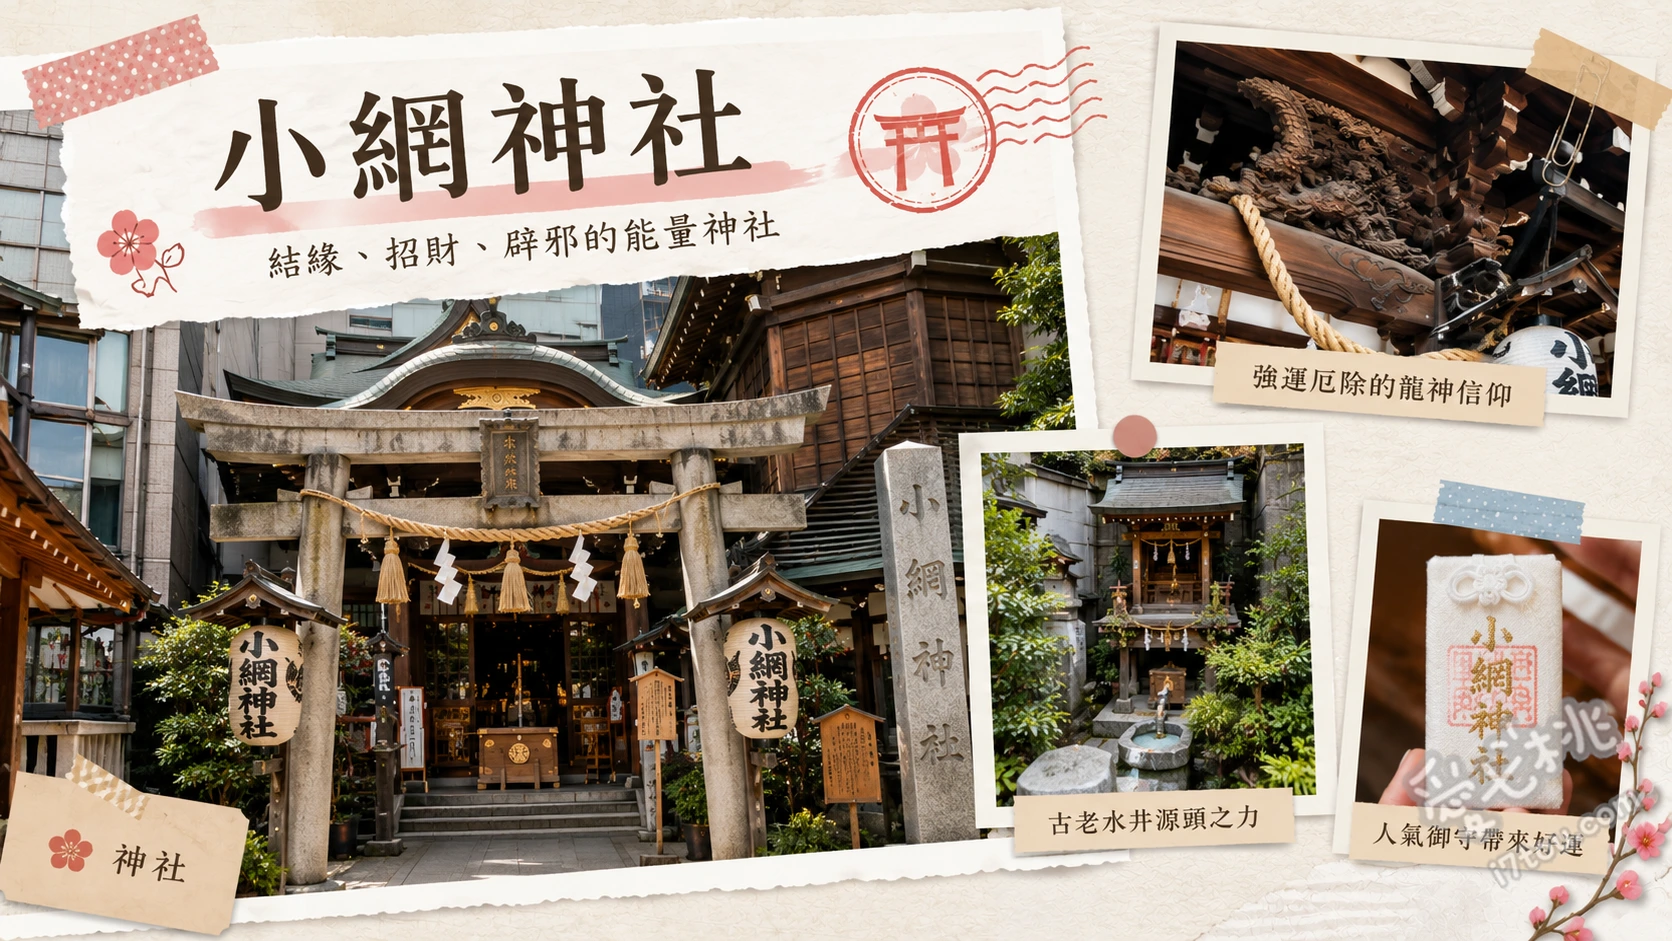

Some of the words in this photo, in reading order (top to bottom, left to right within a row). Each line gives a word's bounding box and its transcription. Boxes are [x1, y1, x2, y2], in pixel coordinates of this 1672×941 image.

[238, 630, 279, 739] 小網神社
[748, 623, 789, 732] 小網神社
[900, 484, 964, 765] 小網神社
[1469, 615, 1514, 785] 小網神社
